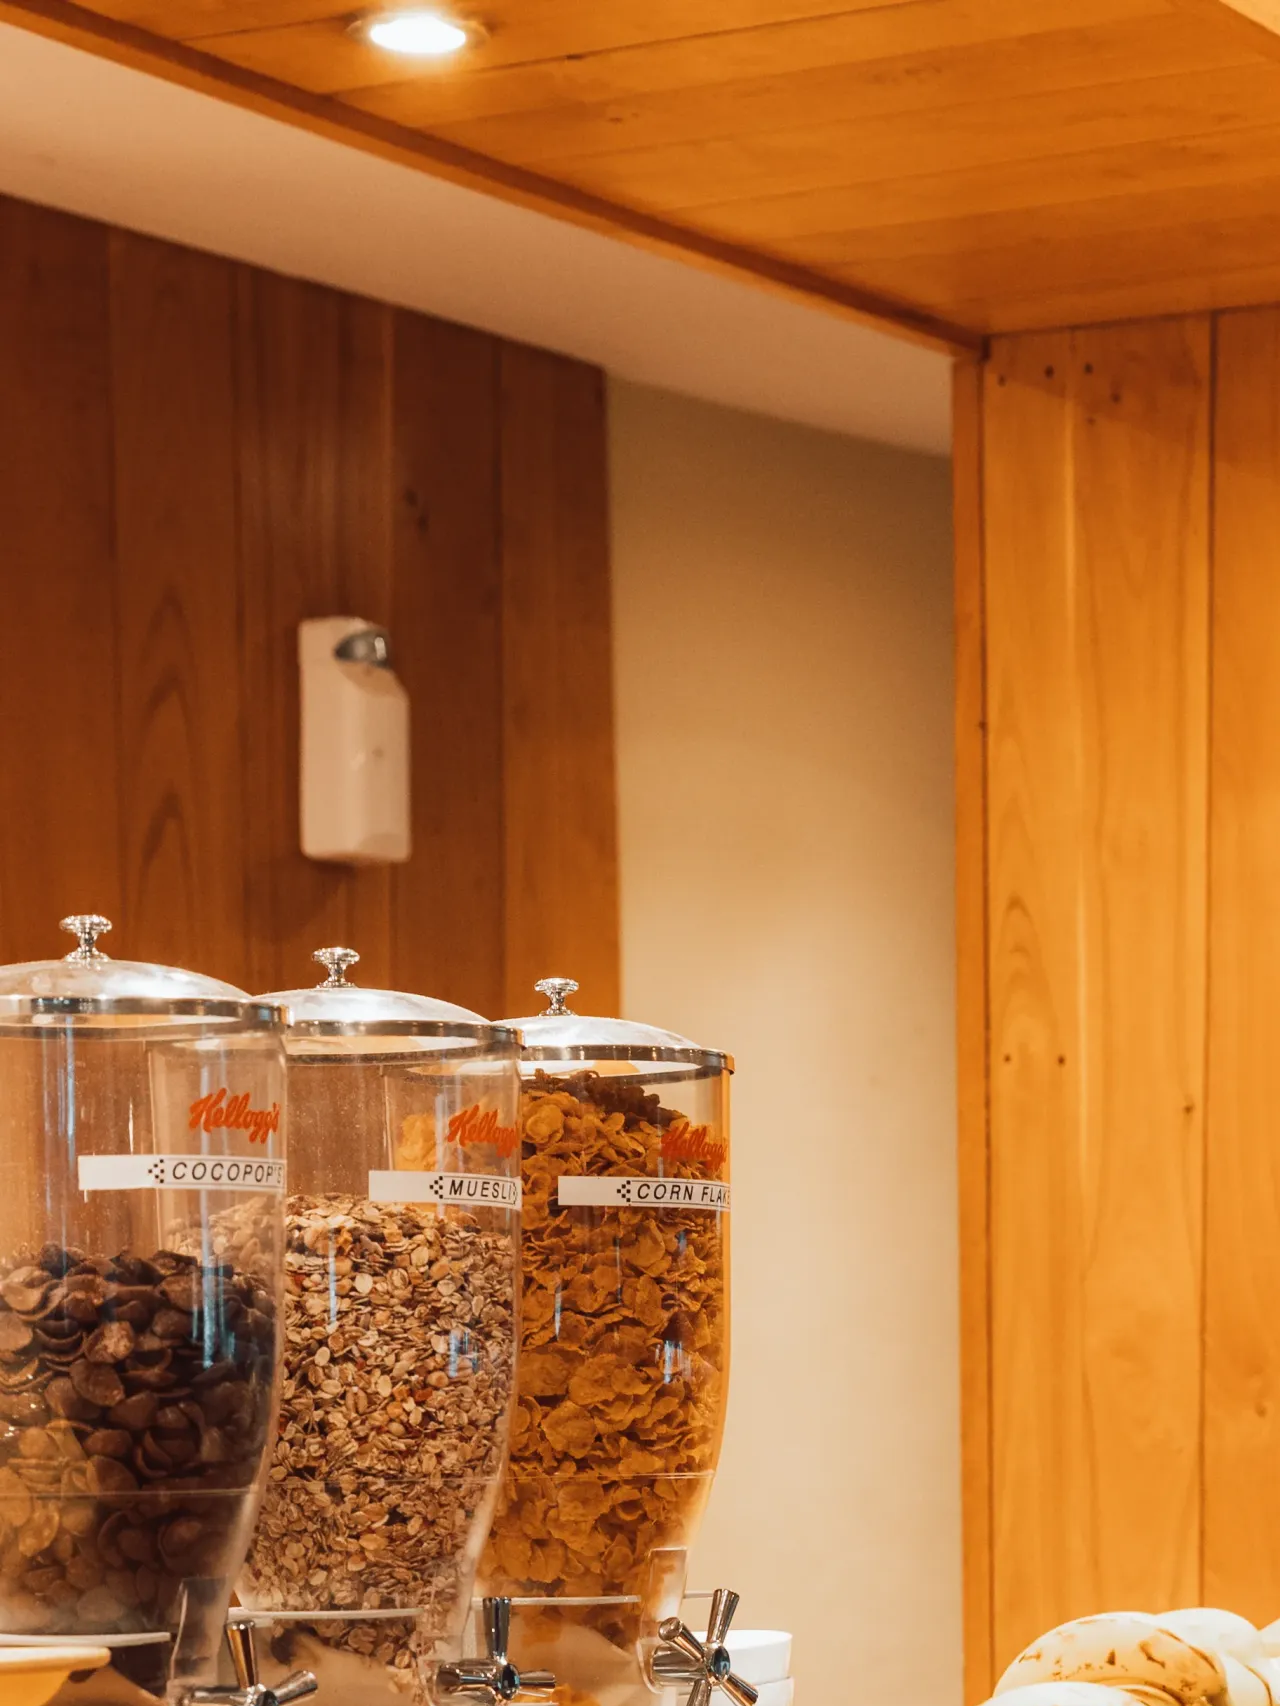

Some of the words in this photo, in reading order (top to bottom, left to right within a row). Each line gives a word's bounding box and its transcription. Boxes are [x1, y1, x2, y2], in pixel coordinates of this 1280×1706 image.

[188, 1087, 280, 1144] Kellogg's
[448, 1179, 512, 1200] MUESLI
[637, 1183, 694, 1201] CORN
